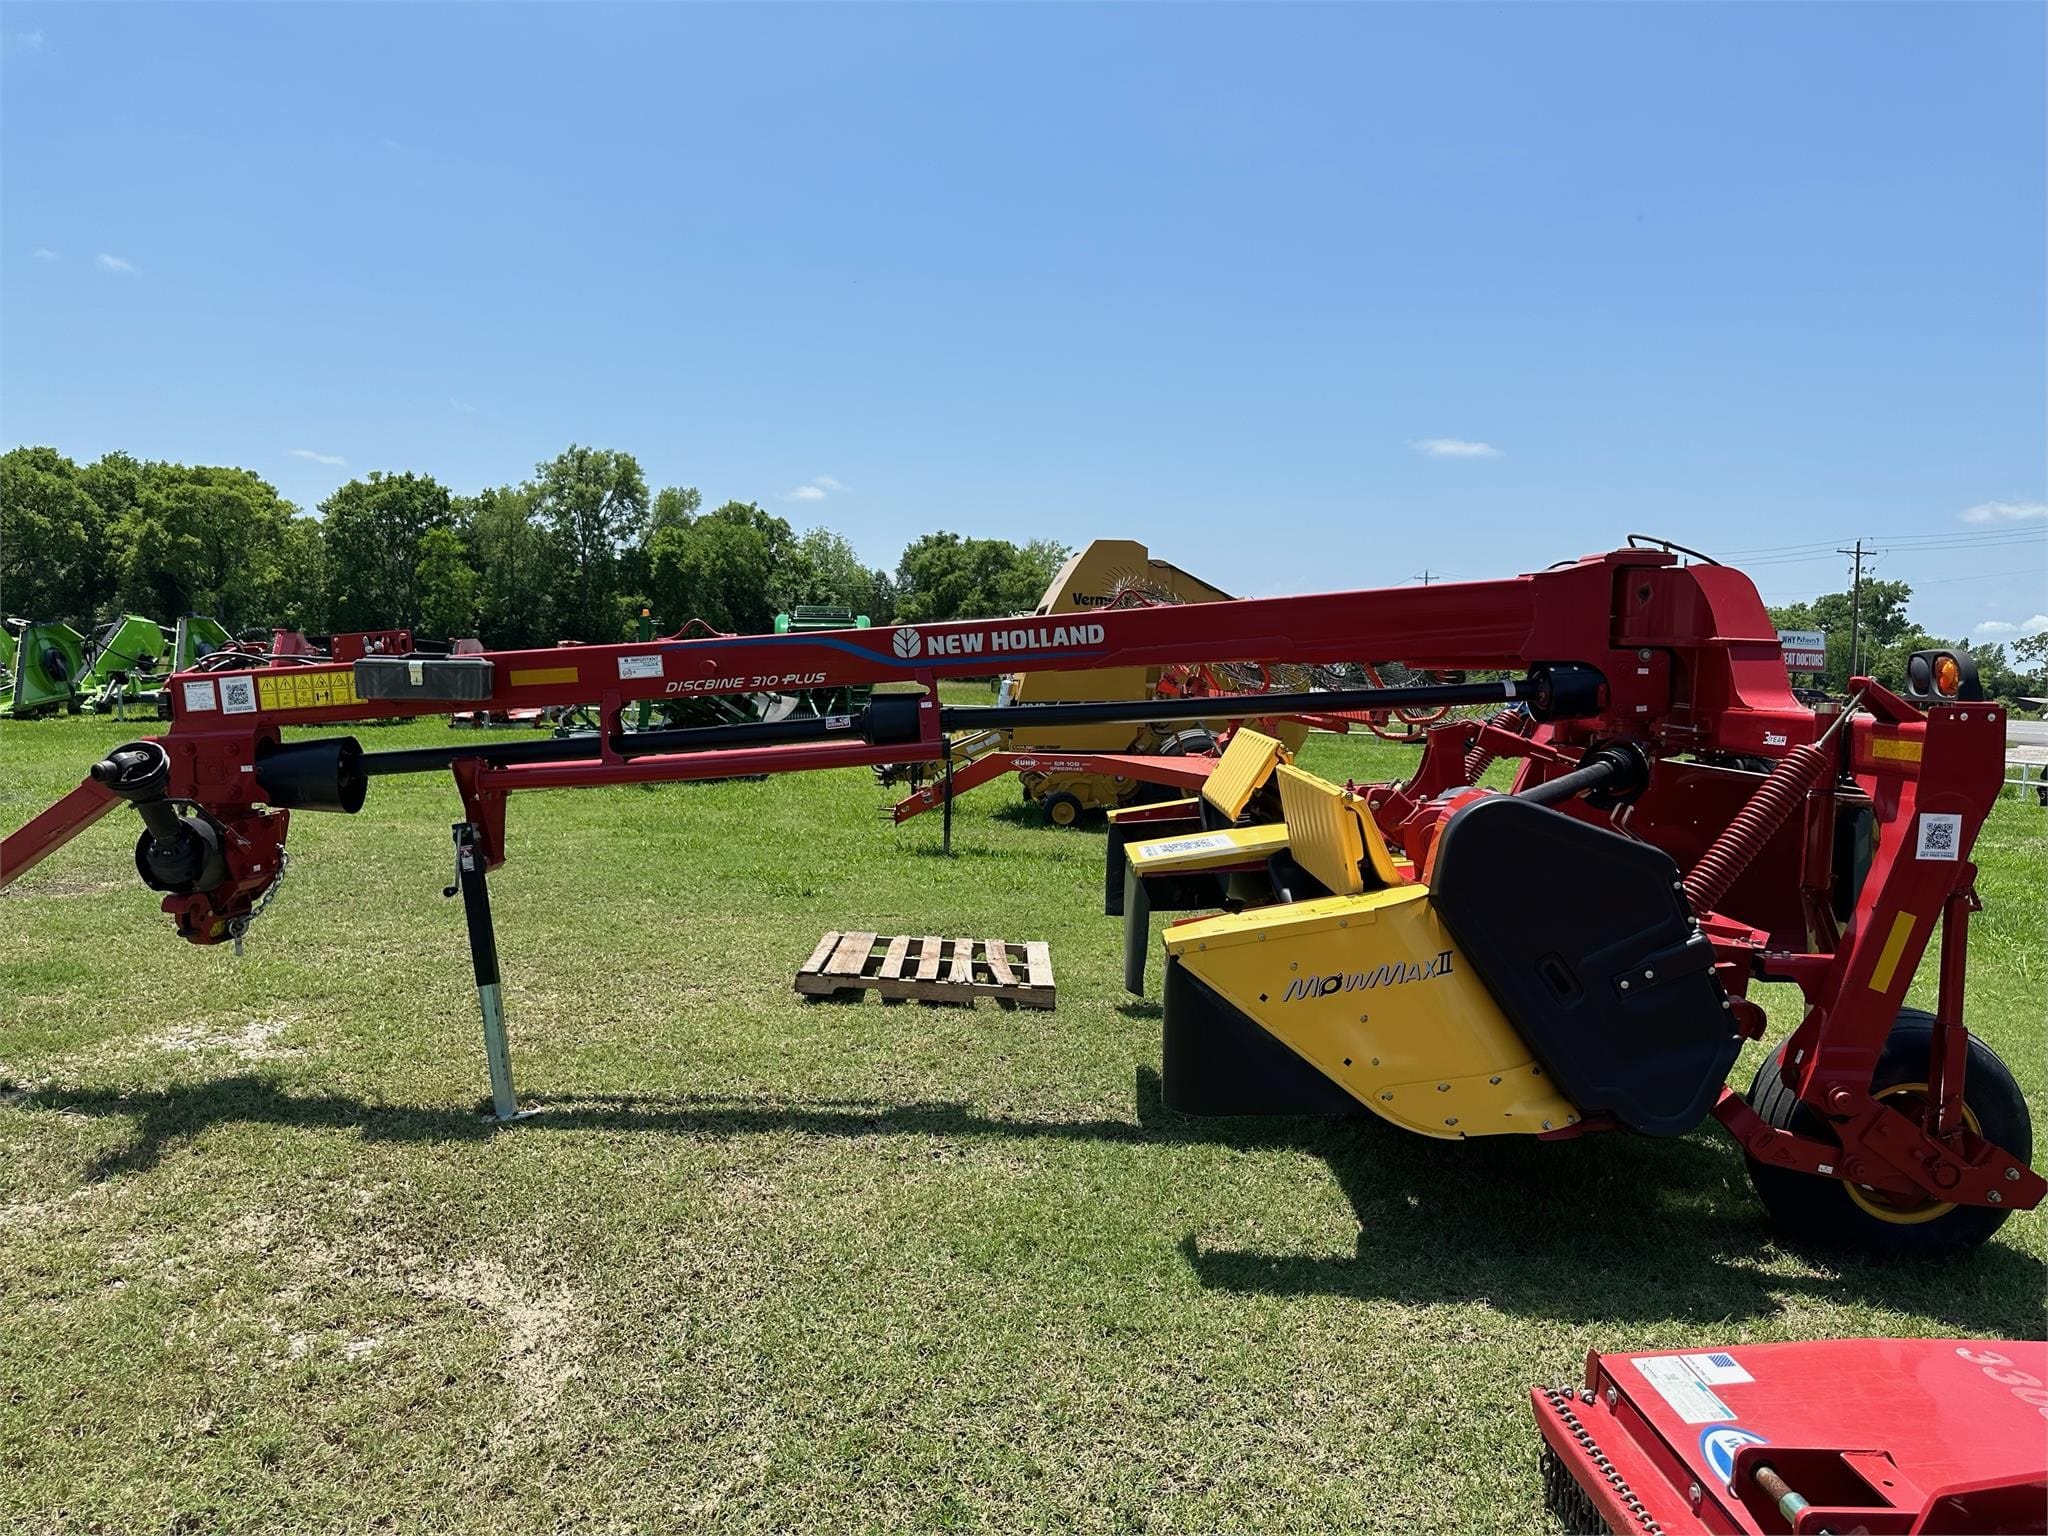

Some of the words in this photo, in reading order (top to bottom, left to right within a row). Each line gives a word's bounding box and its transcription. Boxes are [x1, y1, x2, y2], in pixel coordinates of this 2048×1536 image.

[927, 633, 984, 656] NEW
[991, 624, 1105, 652] HOLLAND
[1796, 653, 1824, 667] DOCTORS
[665, 677, 745, 693] DISCBINE
[750, 676, 778, 687] 310
[1014, 759, 1036, 767] KUHN
[1955, 1346, 2048, 1420] 330
